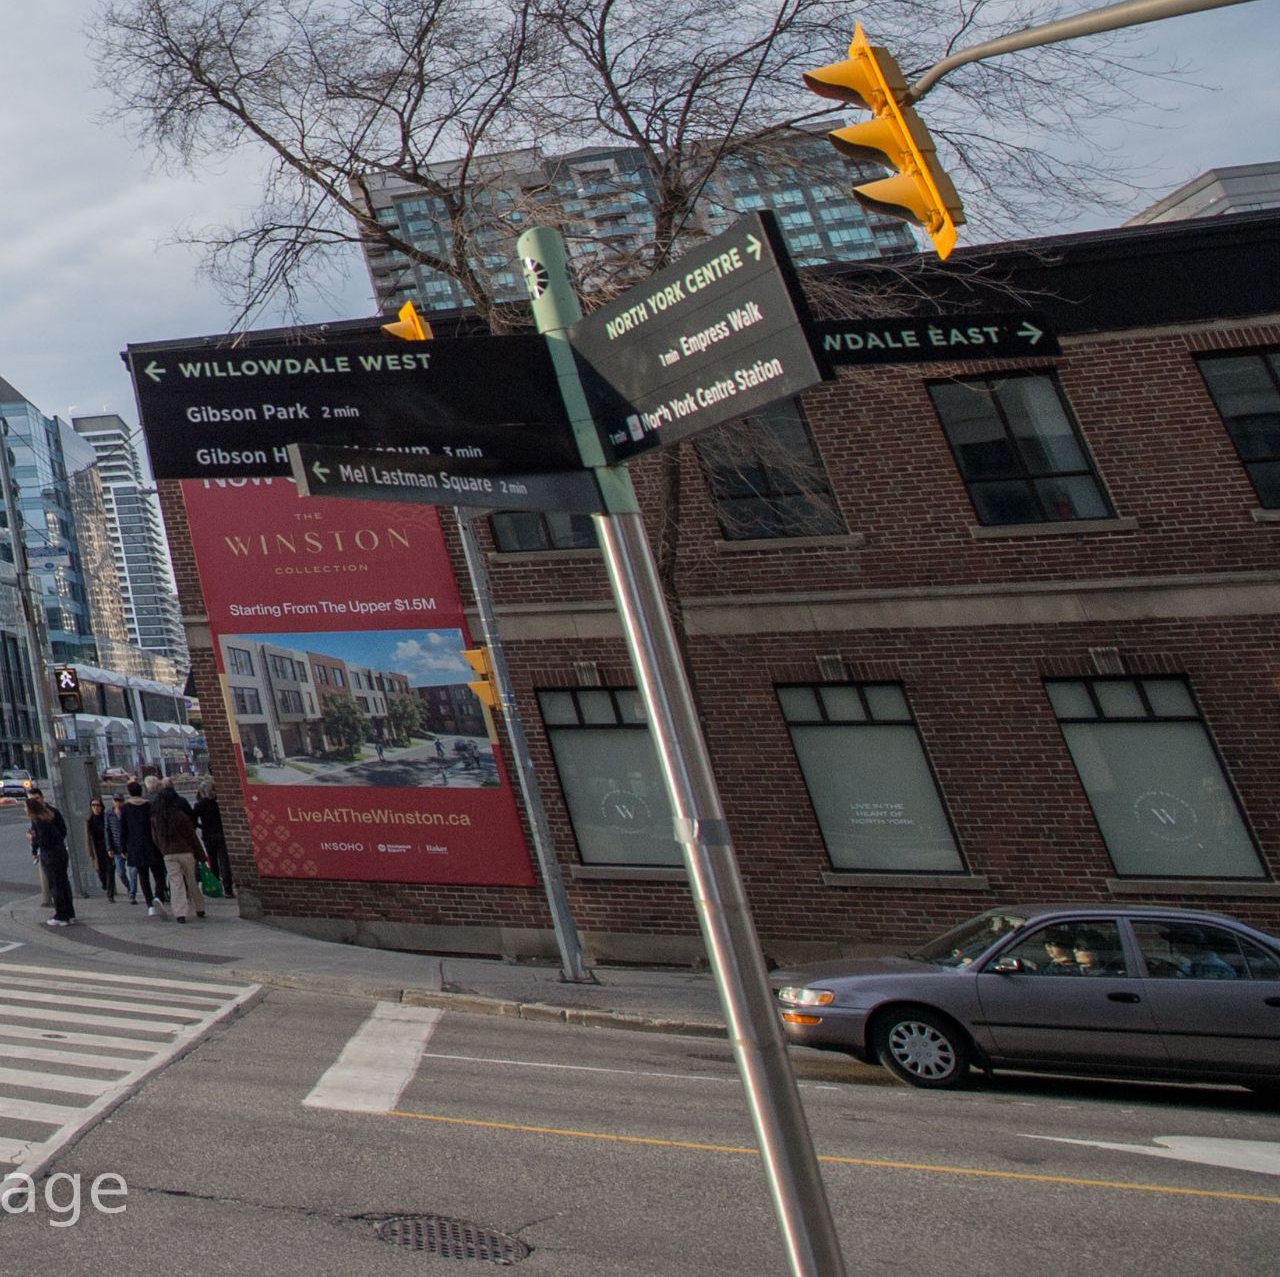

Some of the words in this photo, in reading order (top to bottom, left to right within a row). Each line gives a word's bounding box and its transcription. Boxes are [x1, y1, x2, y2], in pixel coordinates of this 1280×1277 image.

[606, 302, 647, 340] NORTH
[647, 280, 686, 314] YORK
[685, 247, 744, 294] CENTRE
[659, 354, 667, 367] 1
[666, 348, 681, 364] min
[680, 319, 730, 357] Empress
[727, 301, 764, 332] Walk
[929, 326, 999, 346] EAST
[178, 356, 352, 379] WILLOWDALE
[358, 353, 432, 372] WEST
[670, 392, 699, 420] York
[695, 378, 737, 408] Centre
[734, 356, 784, 391] Station
[187, 405, 257, 423] Gibson
[262, 402, 310, 421] Park
[321, 406, 331, 419] 2
[334, 404, 361, 418] min
[196, 447, 268, 465] Gibson
[456, 444, 484, 459] min
[339, 463, 369, 484] Mel
[372, 465, 438, 489] Lastman
[441, 472, 493, 494] Square
[499, 480, 509, 494] 2
[509, 482, 528, 495] min
[294, 512, 323, 521] THE
[224, 528, 411, 556] WINSTON
[274, 564, 369, 575] COLLECTION
[229, 603, 281, 618] Starting
[283, 603, 317, 615] From
[319, 601, 347, 614] The
[349, 600, 392, 616] Upper
[394, 597, 437, 611] $1.5M
[287, 806, 472, 826] LiveAtTheWinston.ca
[320, 842, 364, 852] INSOHO
